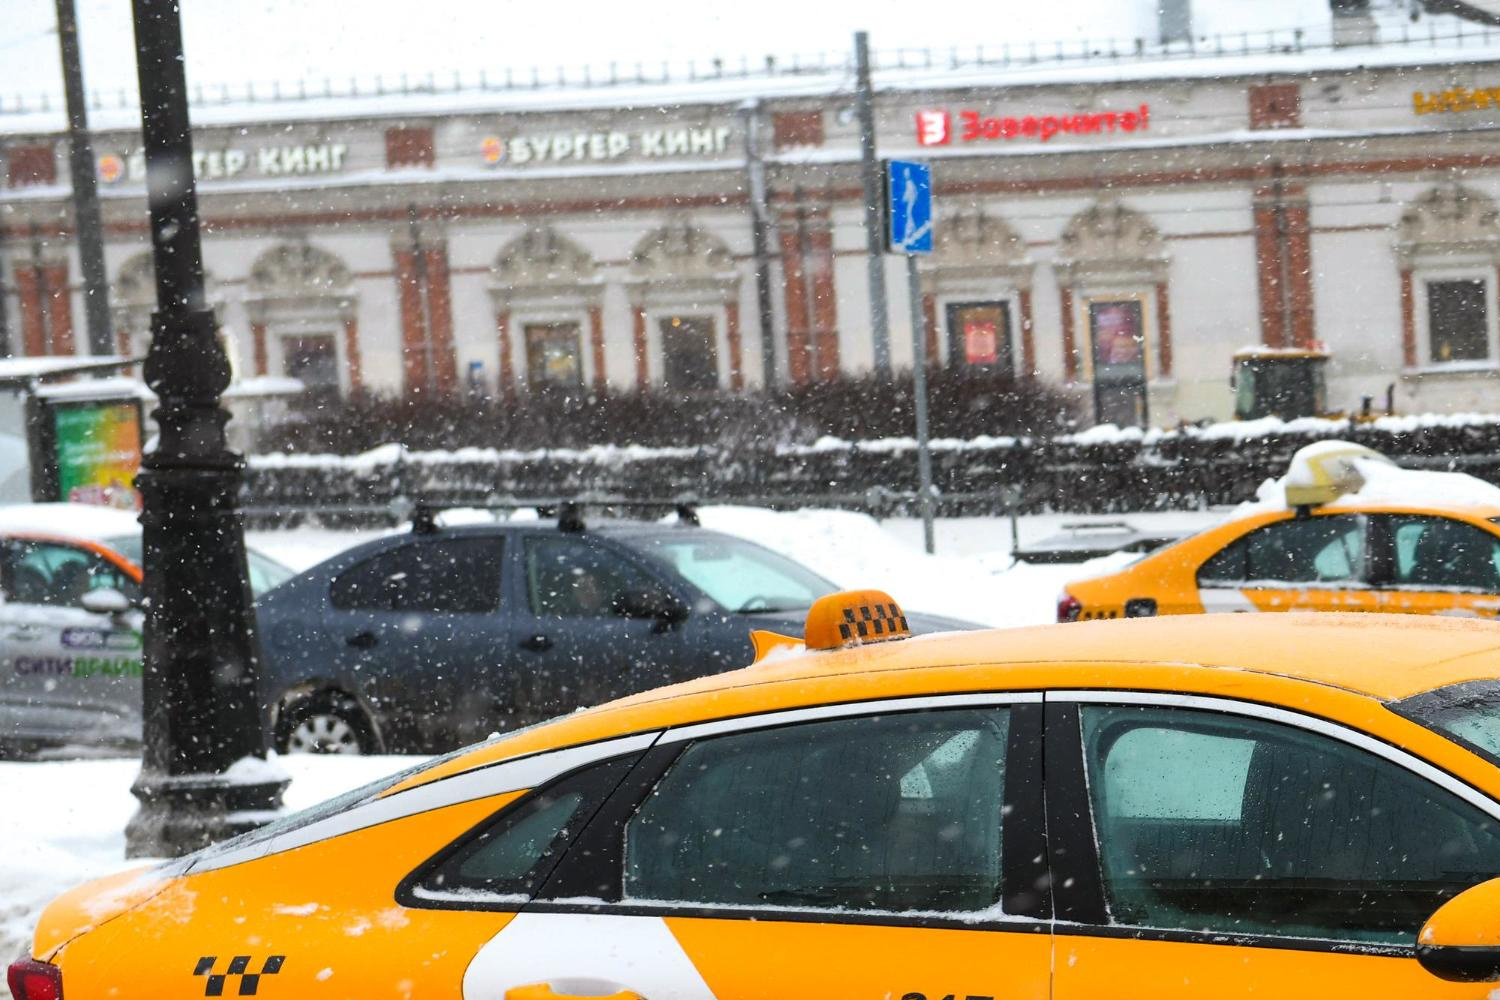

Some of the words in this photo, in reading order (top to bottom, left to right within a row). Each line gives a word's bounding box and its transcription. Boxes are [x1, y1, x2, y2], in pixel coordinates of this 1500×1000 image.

[959, 103, 1150, 142] Заверните!
[256, 144, 346, 175] КИНГ
[508, 132, 628, 163] БУРГЕР
[641, 127, 731, 156] КИНГ
